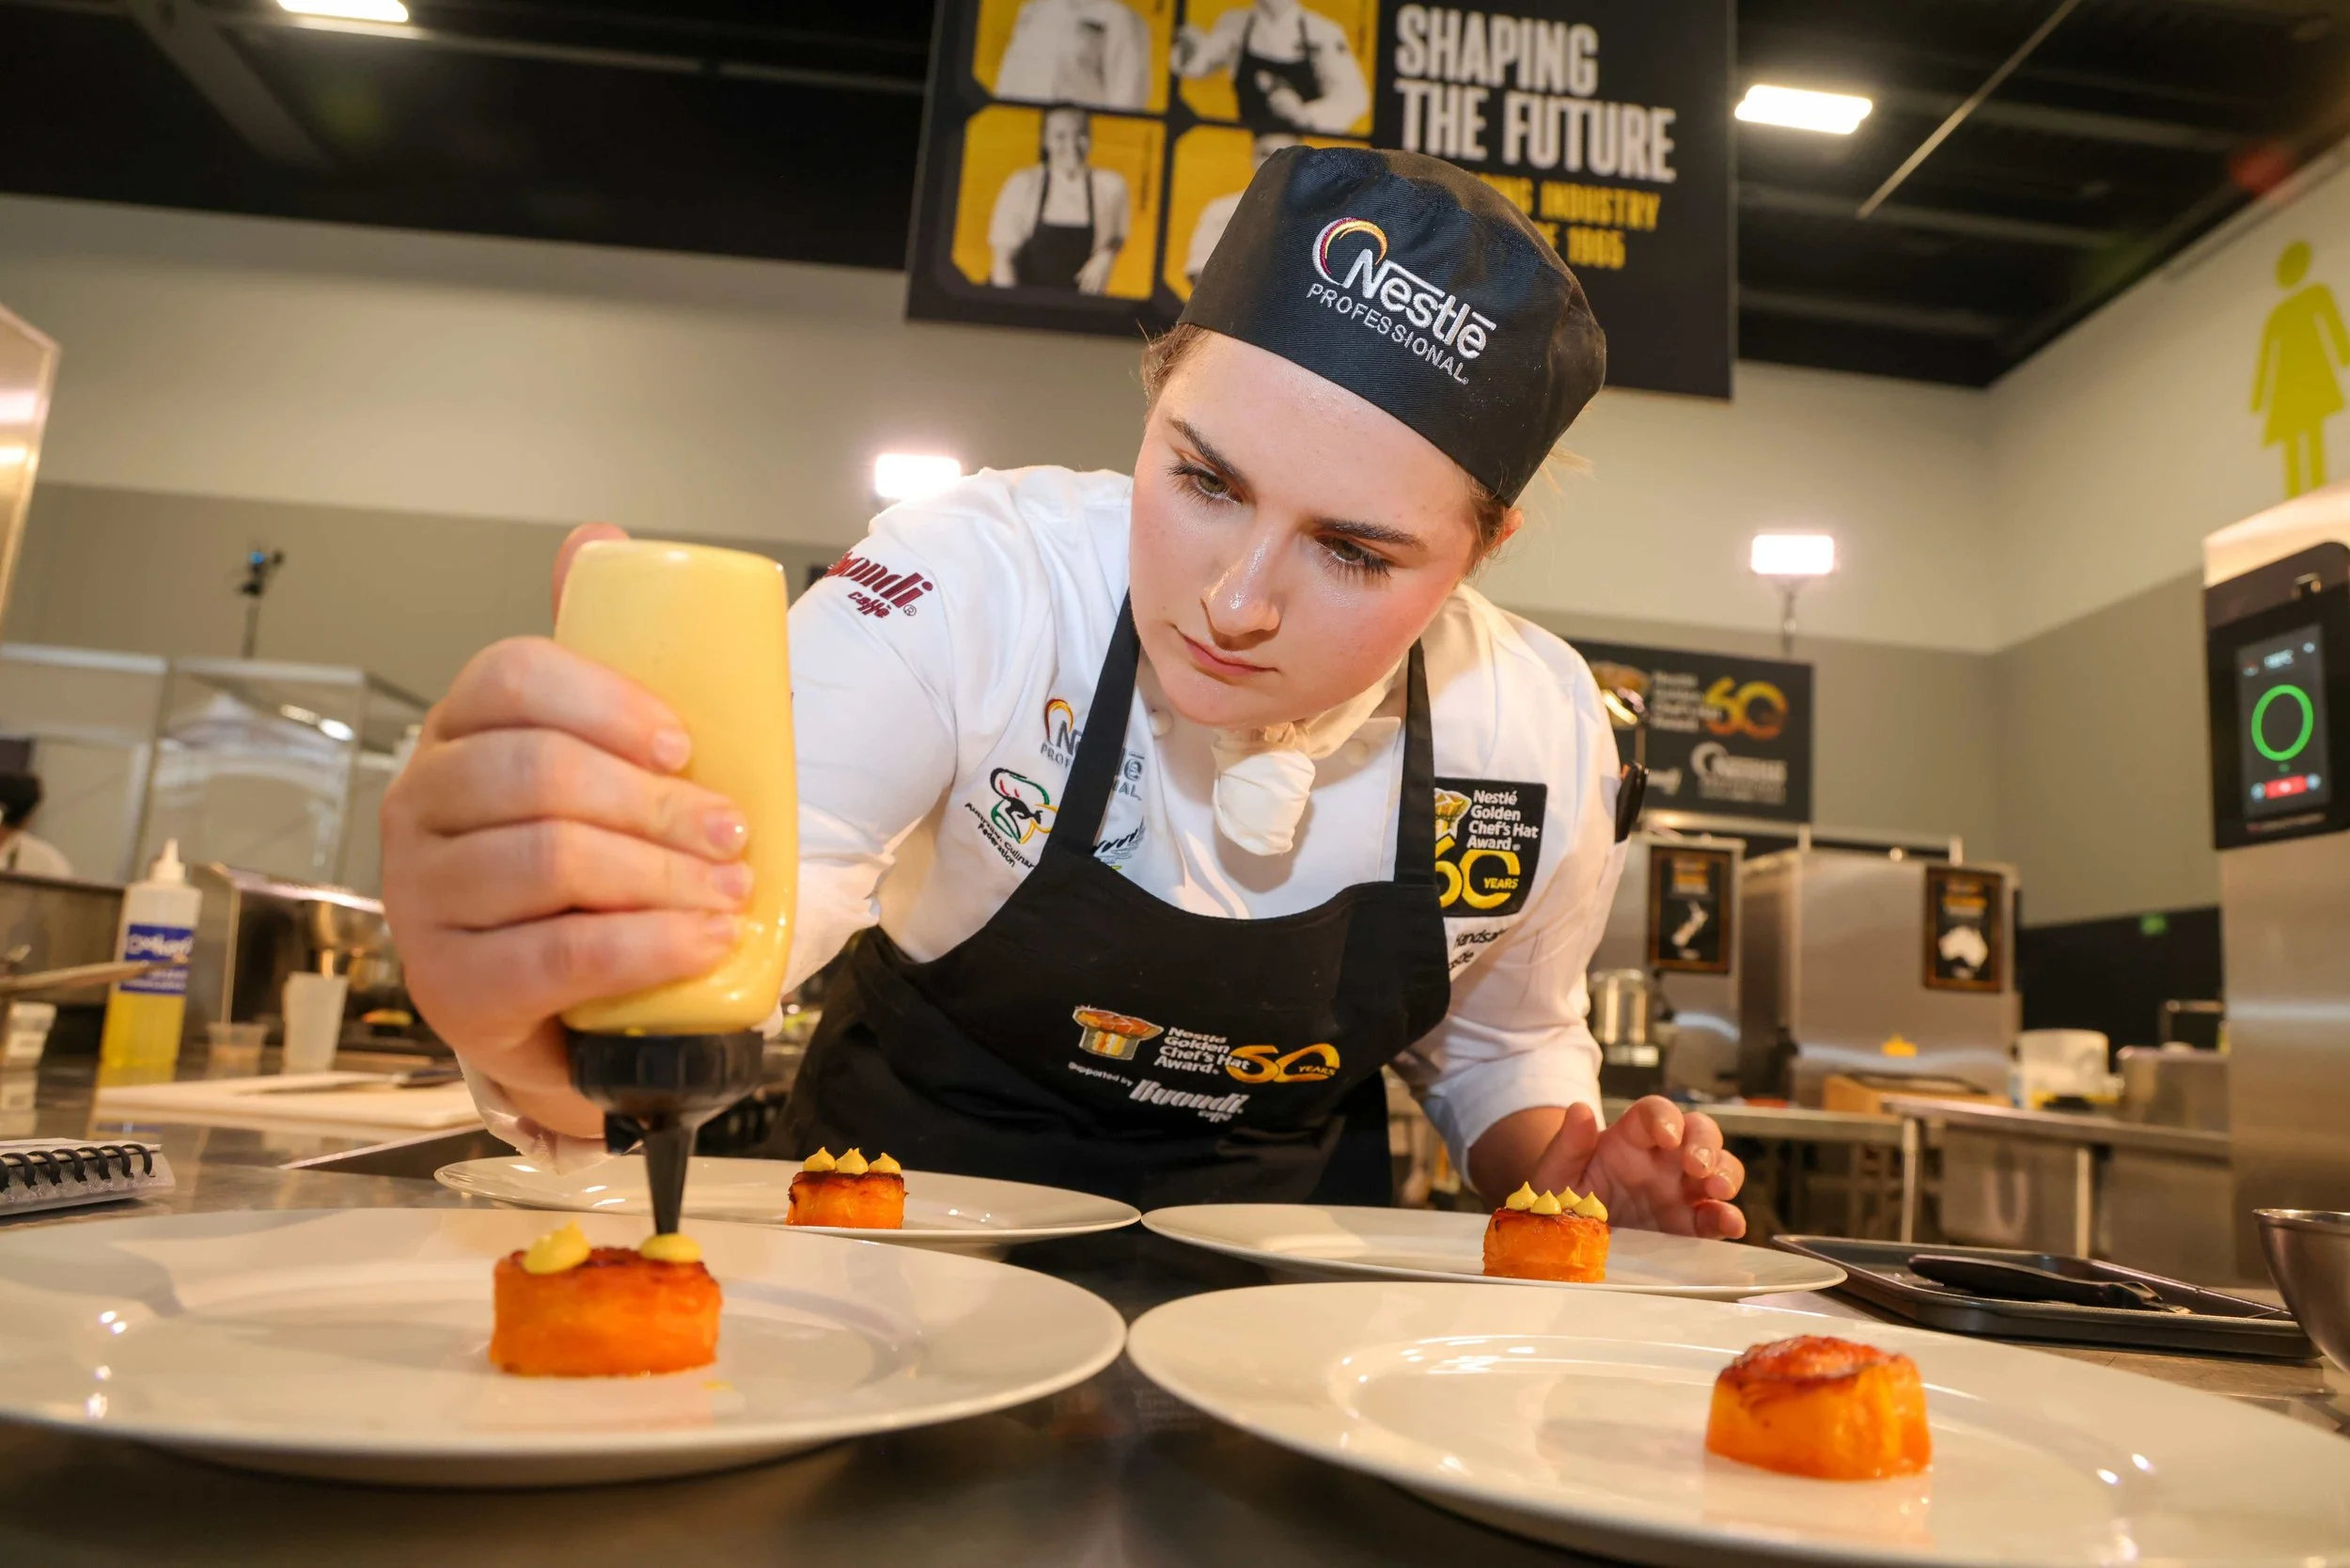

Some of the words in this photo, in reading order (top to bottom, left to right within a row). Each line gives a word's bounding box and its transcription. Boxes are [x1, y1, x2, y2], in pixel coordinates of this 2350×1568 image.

[1394, 4, 1599, 97] SHAPING
[1393, 79, 1489, 162] THE
[1502, 89, 1677, 183] FUTURE
[1539, 180, 1661, 231] INDUSTRY
[1307, 283, 1464, 382] PROFESSIONAL
[1703, 676, 1790, 741] 60
[1473, 790, 1518, 807] Nestlé
[1470, 806, 1522, 822] Golden
[1468, 821, 1512, 838] Chef's
[1512, 823, 1540, 839] Hat
[1466, 835, 1512, 851] Award
[1004, 841, 1037, 869] Culinar
[1483, 877, 1519, 889] YEARS
[1164, 1036, 1230, 1054] Golden
[1153, 1055, 1213, 1074] Award
[1159, 1045, 1215, 1062] Chef's
[1217, 1054, 1251, 1071] Hat
[1226, 1043, 1340, 1084] 60
[1298, 1065, 1336, 1075] YEARS
